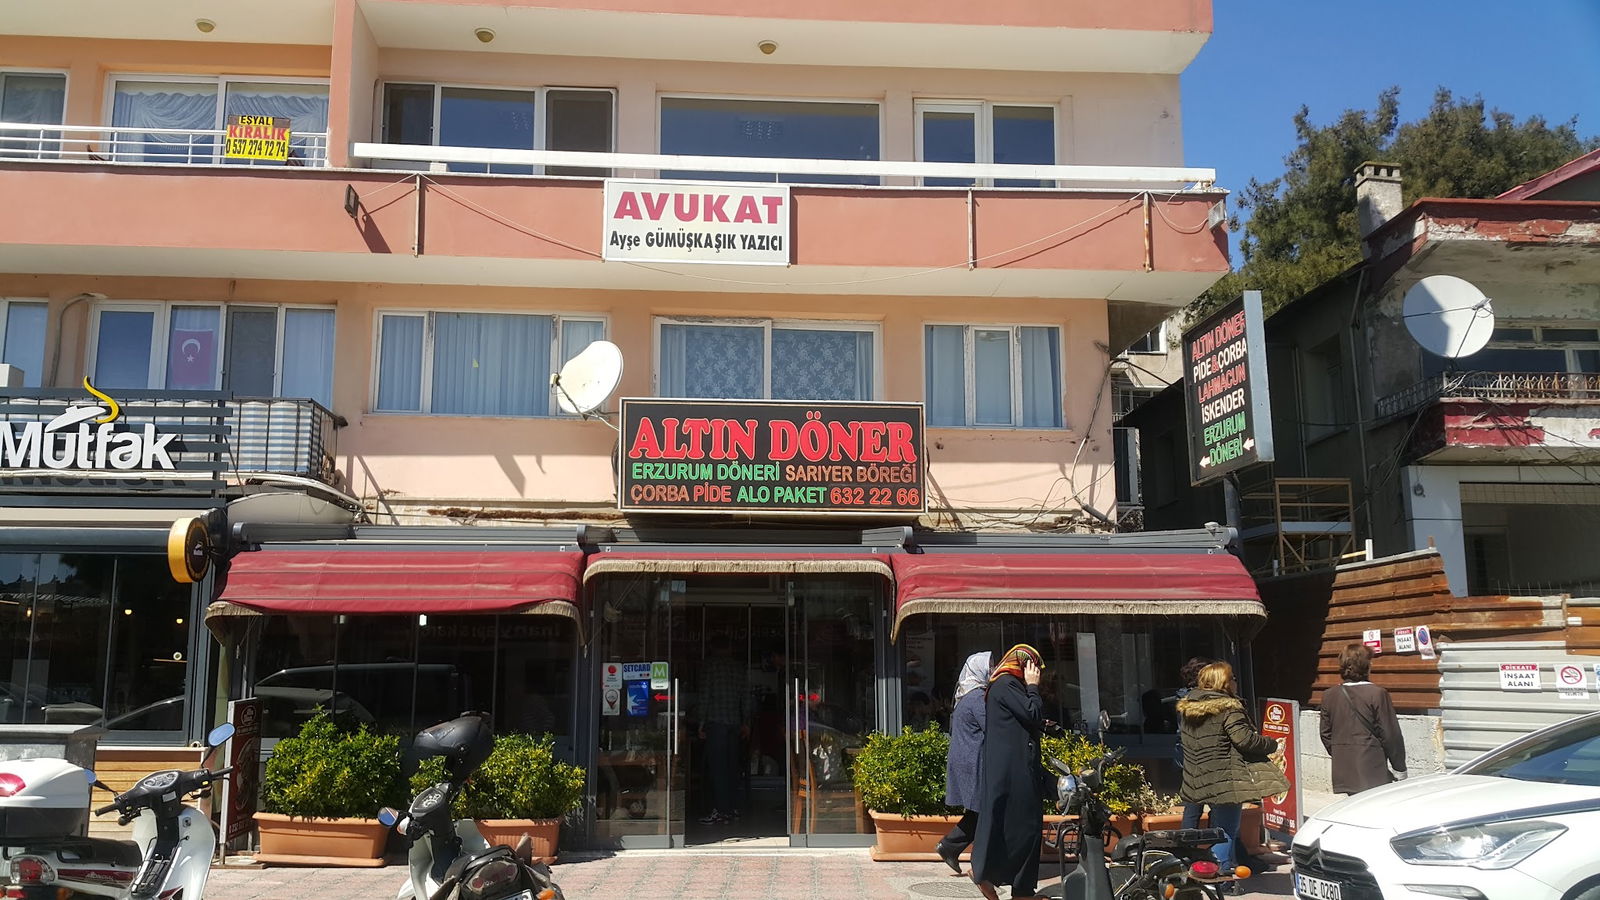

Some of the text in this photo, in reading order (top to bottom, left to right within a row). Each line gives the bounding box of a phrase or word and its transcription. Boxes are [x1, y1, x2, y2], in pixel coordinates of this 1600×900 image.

[226, 139, 286, 157] 0 537 274 72 74
[613, 191, 783, 224] AVUKAT
[610, 227, 783, 253] Ayşe GÜMÜŞKAŞIK YAZICI
[1191, 330, 1215, 362] ALTIN
[1198, 362, 1246, 404] LAHMACUN
[1201, 388, 1245, 424] İSKENDER
[628, 410, 917, 463] ALTIN DÖNER
[1203, 411, 1246, 446] ERZURUM
[1209, 433, 1243, 467] DÖNERİ
[632, 460, 916, 483] ERZURUM DÖNERİ SARIYER BÖREĞİ
[630, 482, 919, 505] ÇORBA PİDE ALO PAKET 632 22 66
[623, 664, 651, 672] SETCARD
[1309, 878, 1318, 897] DE
